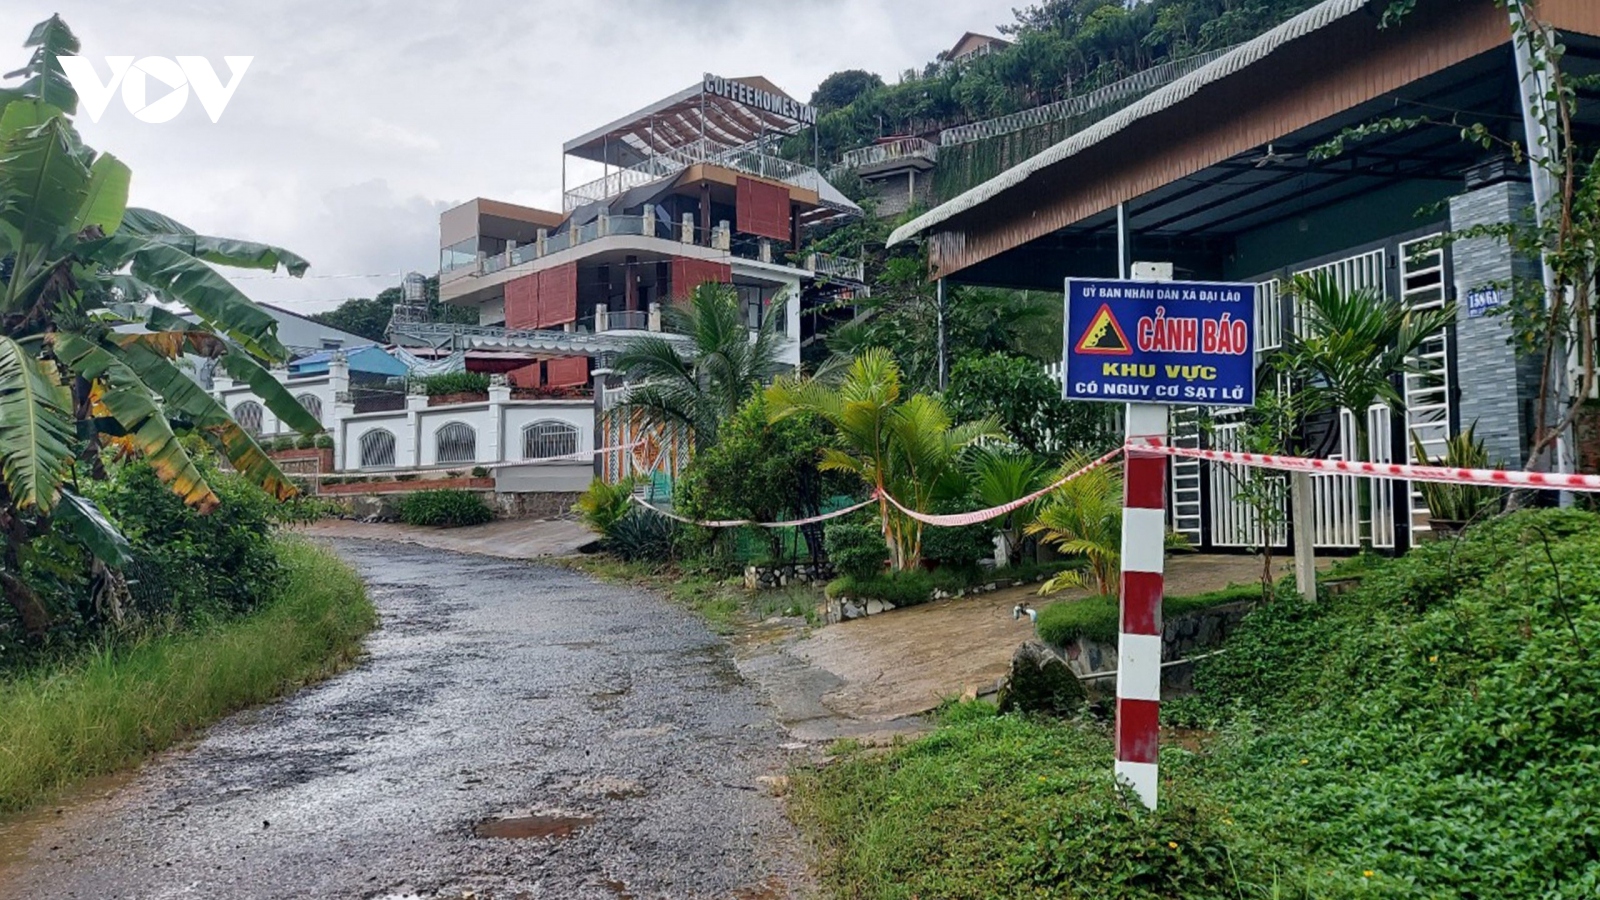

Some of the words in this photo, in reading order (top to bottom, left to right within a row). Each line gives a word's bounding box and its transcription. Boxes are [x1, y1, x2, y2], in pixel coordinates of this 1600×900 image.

[1099, 288, 1121, 298] BAN
[1124, 287, 1153, 299] NHÂN
[1157, 287, 1179, 300] DÂN
[1182, 288, 1196, 300] XÃ
[1199, 290, 1217, 303] ĐẠI
[1137, 305, 1198, 353] CẢNH
[1202, 312, 1247, 355] BÁO
[1102, 362, 1156, 378] KHU
[1164, 363, 1217, 383] VỰC
[1075, 380, 1098, 394] CÓ
[1103, 383, 1150, 396] NGUY
[1155, 384, 1179, 397] CƠ
[1184, 386, 1217, 400] SẠT
[1222, 384, 1244, 400] LỞ
